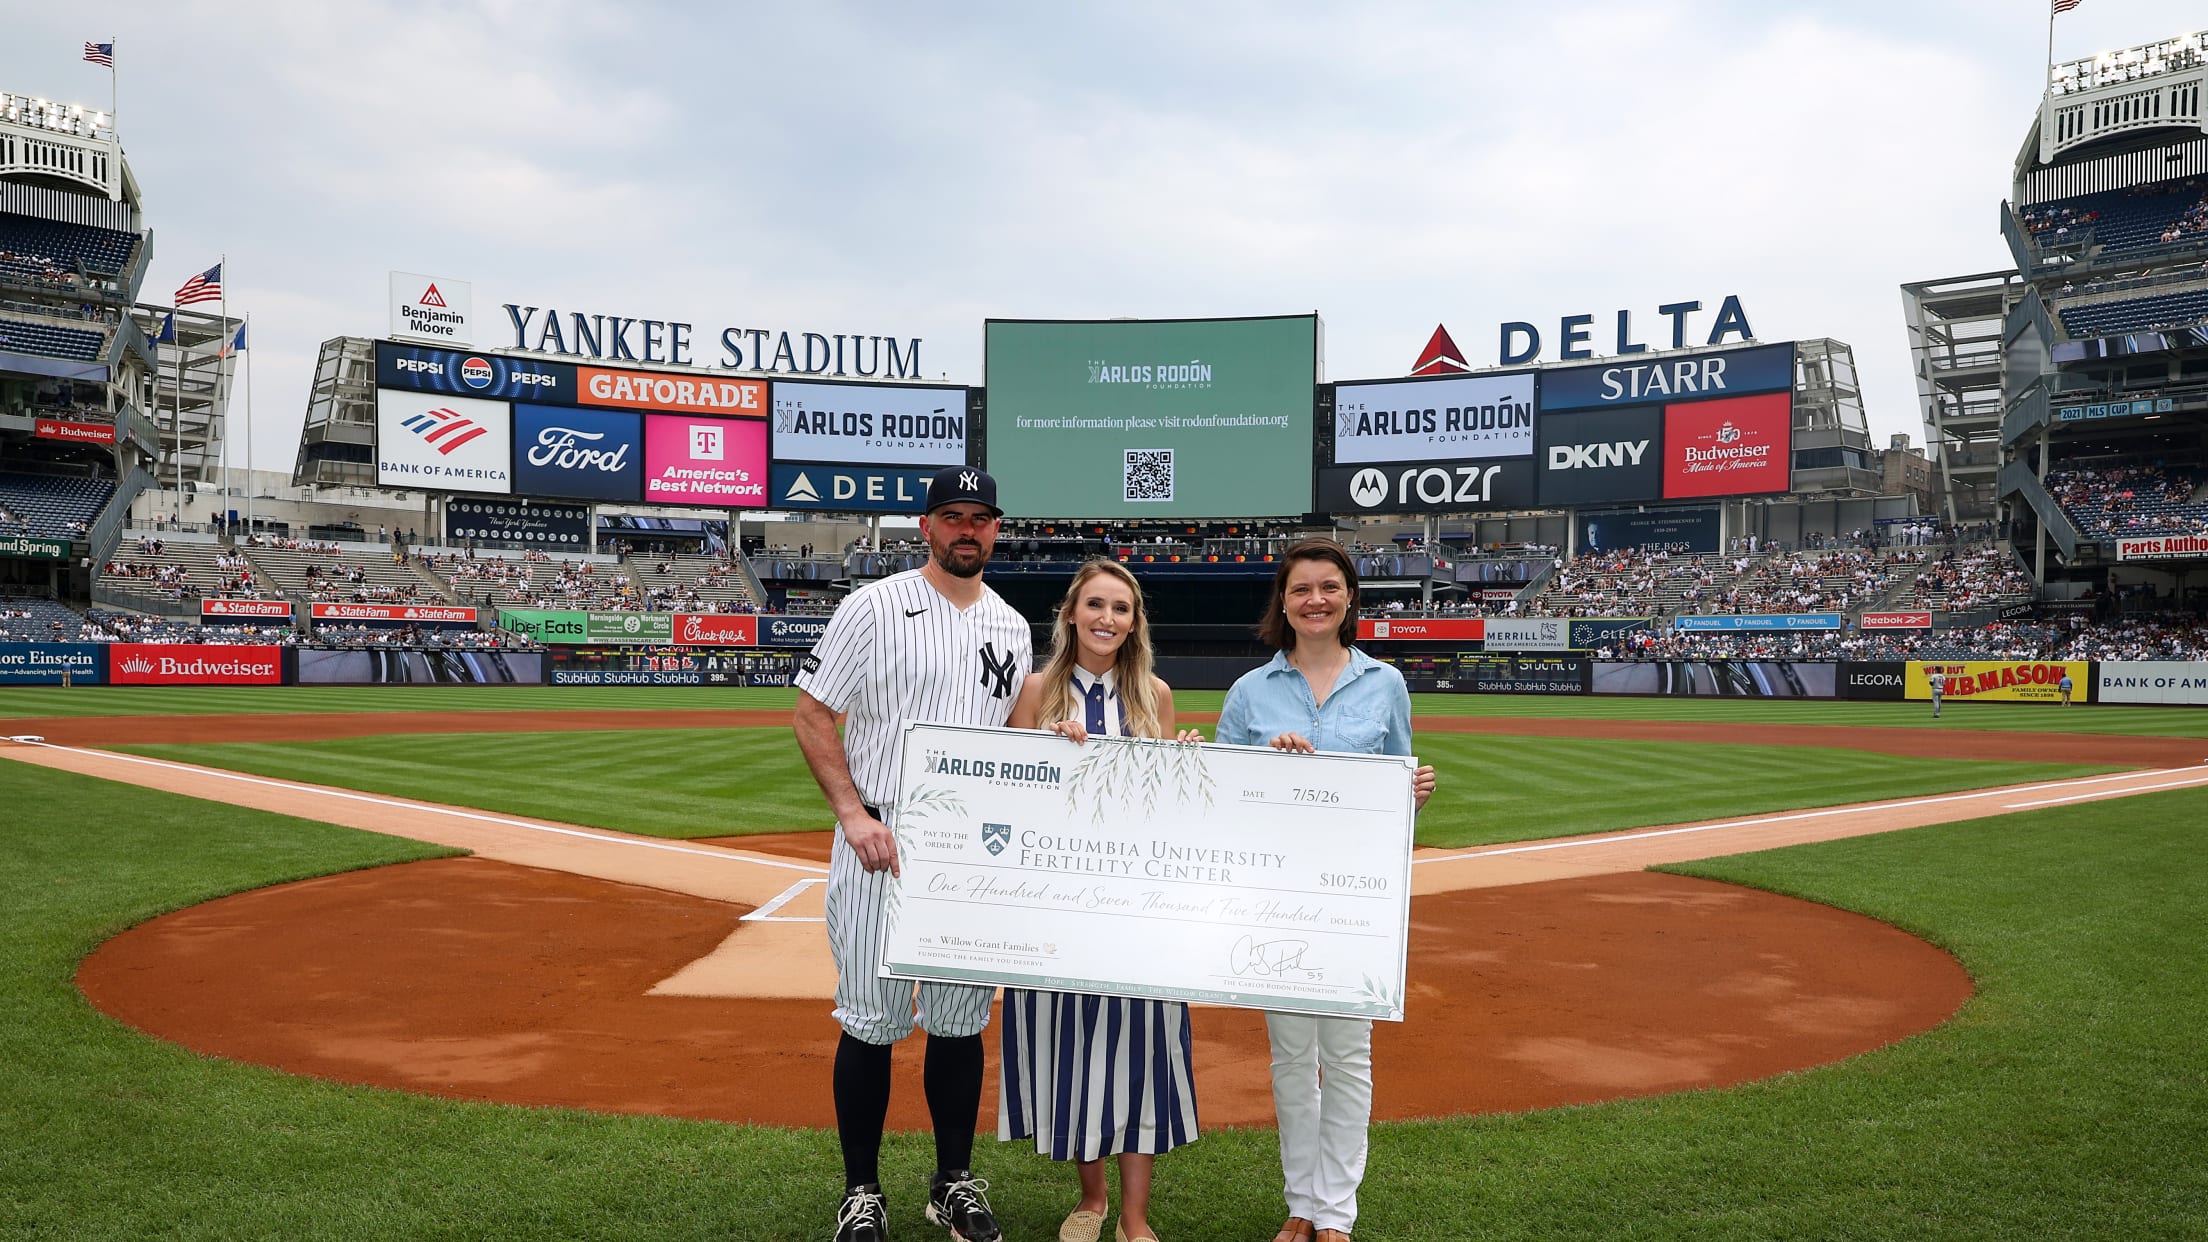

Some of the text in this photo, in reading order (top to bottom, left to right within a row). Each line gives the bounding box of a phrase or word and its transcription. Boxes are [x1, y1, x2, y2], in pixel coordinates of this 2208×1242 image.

[402, 304, 464, 325] Benjamin
[410, 319, 454, 336] Moore
[1500, 294, 1753, 366] DELTA
[502, 303, 923, 379] YANKEE STADIUM
[396, 358, 556, 387] PEPSI PEPSI PEPSI
[1157, 359, 1212, 383] RODÓN
[1601, 357, 1727, 400] STARR
[589, 374, 758, 409] GATORADE
[776, 400, 803, 409] THE
[1339, 403, 1366, 411] THE
[2062, 404, 2128, 419] 2021 MLS CUP
[1446, 395, 1531, 432] RODÓN
[882, 408, 963, 440] RODÓN
[1016, 413, 1289, 431] for more information please visit rodonfoundation.org
[60, 426, 112, 440] Budweiser
[1429, 430, 1531, 443] FOUNDATION
[527, 427, 630, 472] Ford
[866, 440, 964, 450] FOUNDATION
[1685, 443, 1770, 462] Budweiser
[1548, 440, 1650, 471] DKNY
[381, 462, 507, 481] BANK OF AMERICA
[662, 466, 750, 482] America's
[1683, 458, 1768, 474] Made of America
[649, 478, 764, 497] Best Network
[834, 475, 930, 501] DELT
[1399, 465, 1501, 504] razr
[488, 516, 548, 530] New York Yankees
[20, 538, 61, 557] Spring
[1640, 540, 1690, 551] THE BOSS
[2122, 536, 2208, 554] Parts Autho
[1483, 590, 1513, 599] TOYOTA
[2001, 604, 2033, 618] LEGORA
[504, 618, 542, 634] Uber
[544, 619, 584, 635] Eats
[653, 622, 669, 630] Circle
[1863, 616, 1903, 625] Reebok
[683, 621, 747, 643] Chick-fil-A
[788, 623, 826, 636] coupa
[1392, 625, 1427, 634] TOYOTA
[1486, 632, 1538, 640] MERRILL
[1600, 629, 1635, 640] CLEA
[0, 650, 94, 665] ore Einstein
[160, 657, 273, 677] Budweiser
[979, 642, 1017, 699] NY
[1923, 665, 1966, 676] WHO BUT
[556, 672, 699, 684] StubHub StubHub StubHub
[710, 673, 725, 682] 399
[1436, 680, 1450, 689] 385
[1850, 673, 1903, 687] LEGORA
[2103, 677, 2149, 689] BANK
[2155, 677, 2176, 689] OF
[1478, 682, 1582, 692] StubHub StubHub StubHub
[926, 748, 946, 756] THE
[1000, 760, 1061, 784] RODÓN
[988, 779, 1060, 791] FOUNDATION
[1243, 788, 1339, 804] DATE 7/5/26
[923, 830, 969, 840] PAY TO THE
[924, 840, 964, 850] ORDER OF
[1319, 871, 1388, 891] $107,500
[928, 872, 1371, 927] One Hundred and Seven Thousand Five Hundred DOLLARS
[940, 935, 973, 948] Willow
[974, 938, 1000, 950] Grant
[1003, 941, 1039, 954] Families
[918, 951, 1044, 967] FUNDING THE FAMILY YOU DESERVE
[1239, 981, 1265, 989] CARLOS
[1266, 982, 1291, 991] RODÓN
[1293, 985, 1338, 995] FOUNDATION
[960, 1170, 969, 1178] 42
[854, 1185, 864, 1193] 42
